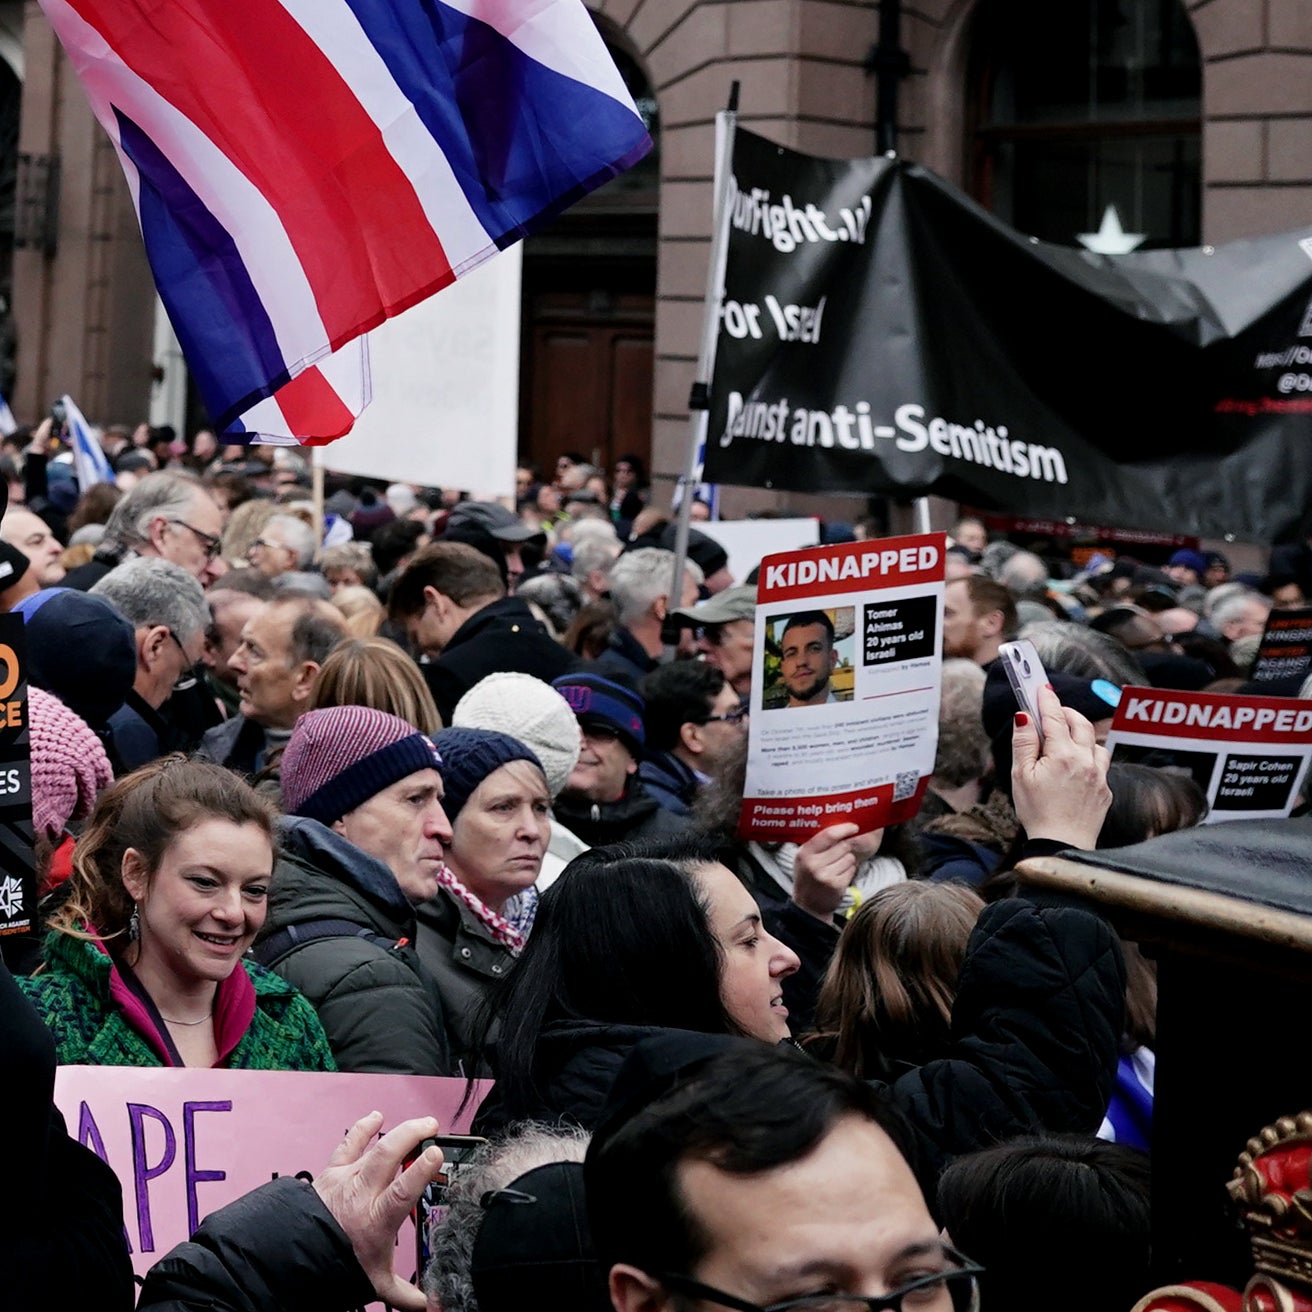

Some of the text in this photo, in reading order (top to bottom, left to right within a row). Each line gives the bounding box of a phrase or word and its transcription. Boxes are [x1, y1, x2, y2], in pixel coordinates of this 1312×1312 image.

[791, 400, 1069, 485] anti-Semitism
[765, 545, 939, 591] KIDNAPPED
[866, 609, 898, 620] Tomer
[880, 634, 907, 648] years
[908, 629, 924, 641] old
[1124, 698, 1312, 733] KIDNAPPED
[753, 797, 879, 816] Please help bring them
[751, 818, 821, 828] home alive.
